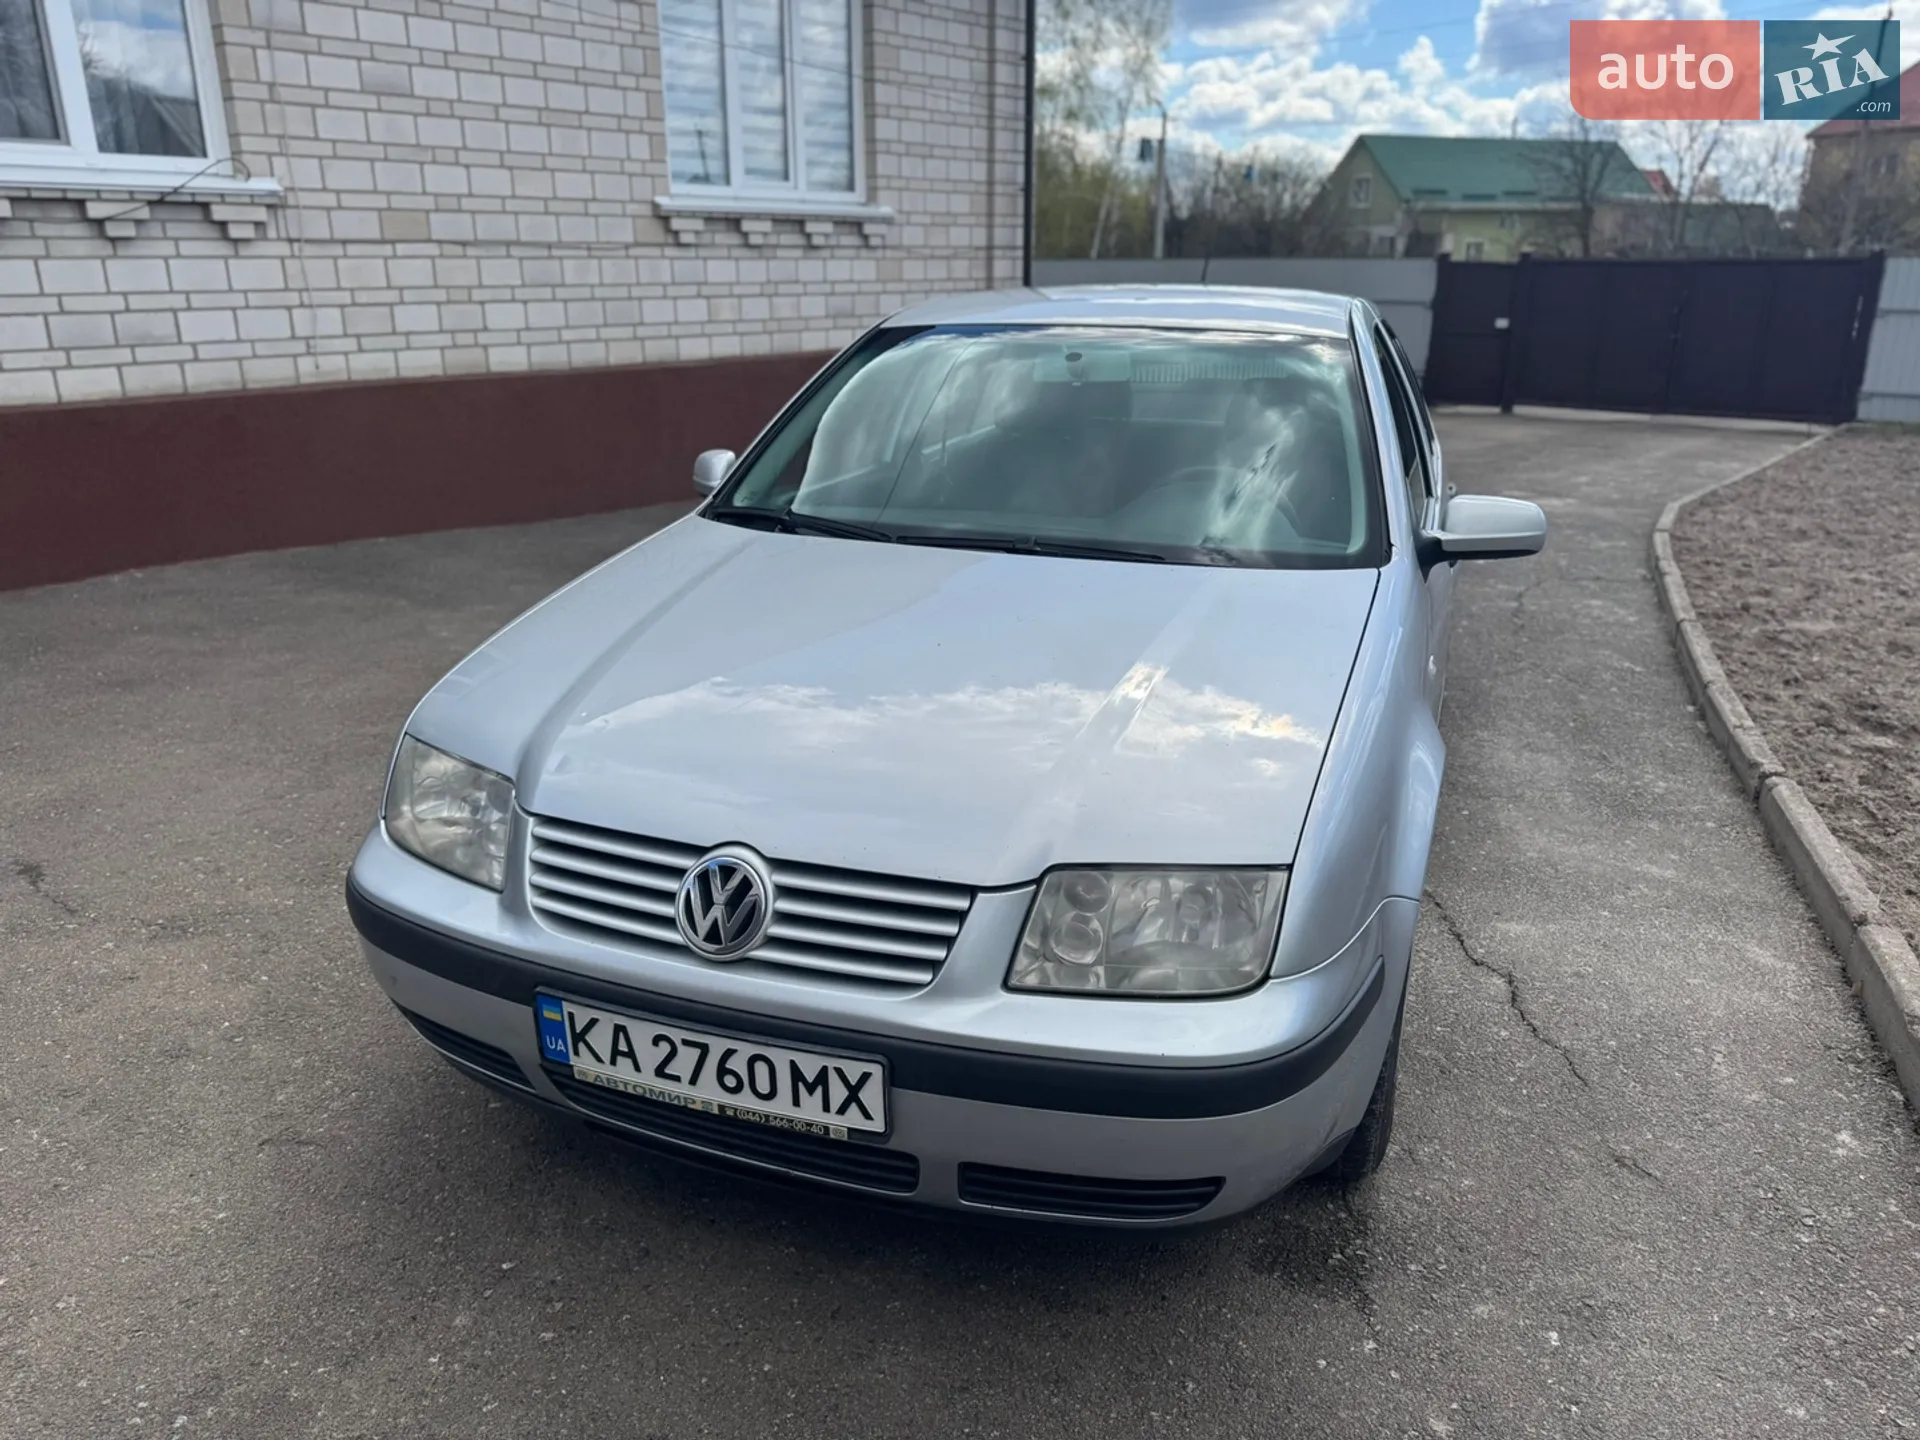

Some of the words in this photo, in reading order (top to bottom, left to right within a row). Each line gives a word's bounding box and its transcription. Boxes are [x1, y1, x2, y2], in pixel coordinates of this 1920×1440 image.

[546, 1034, 567, 1054] UA
[567, 1010, 642, 1073] KA
[651, 1033, 778, 1102] 2760
[788, 1058, 875, 1122] MX
[591, 1073, 697, 1109] АВТОМИР
